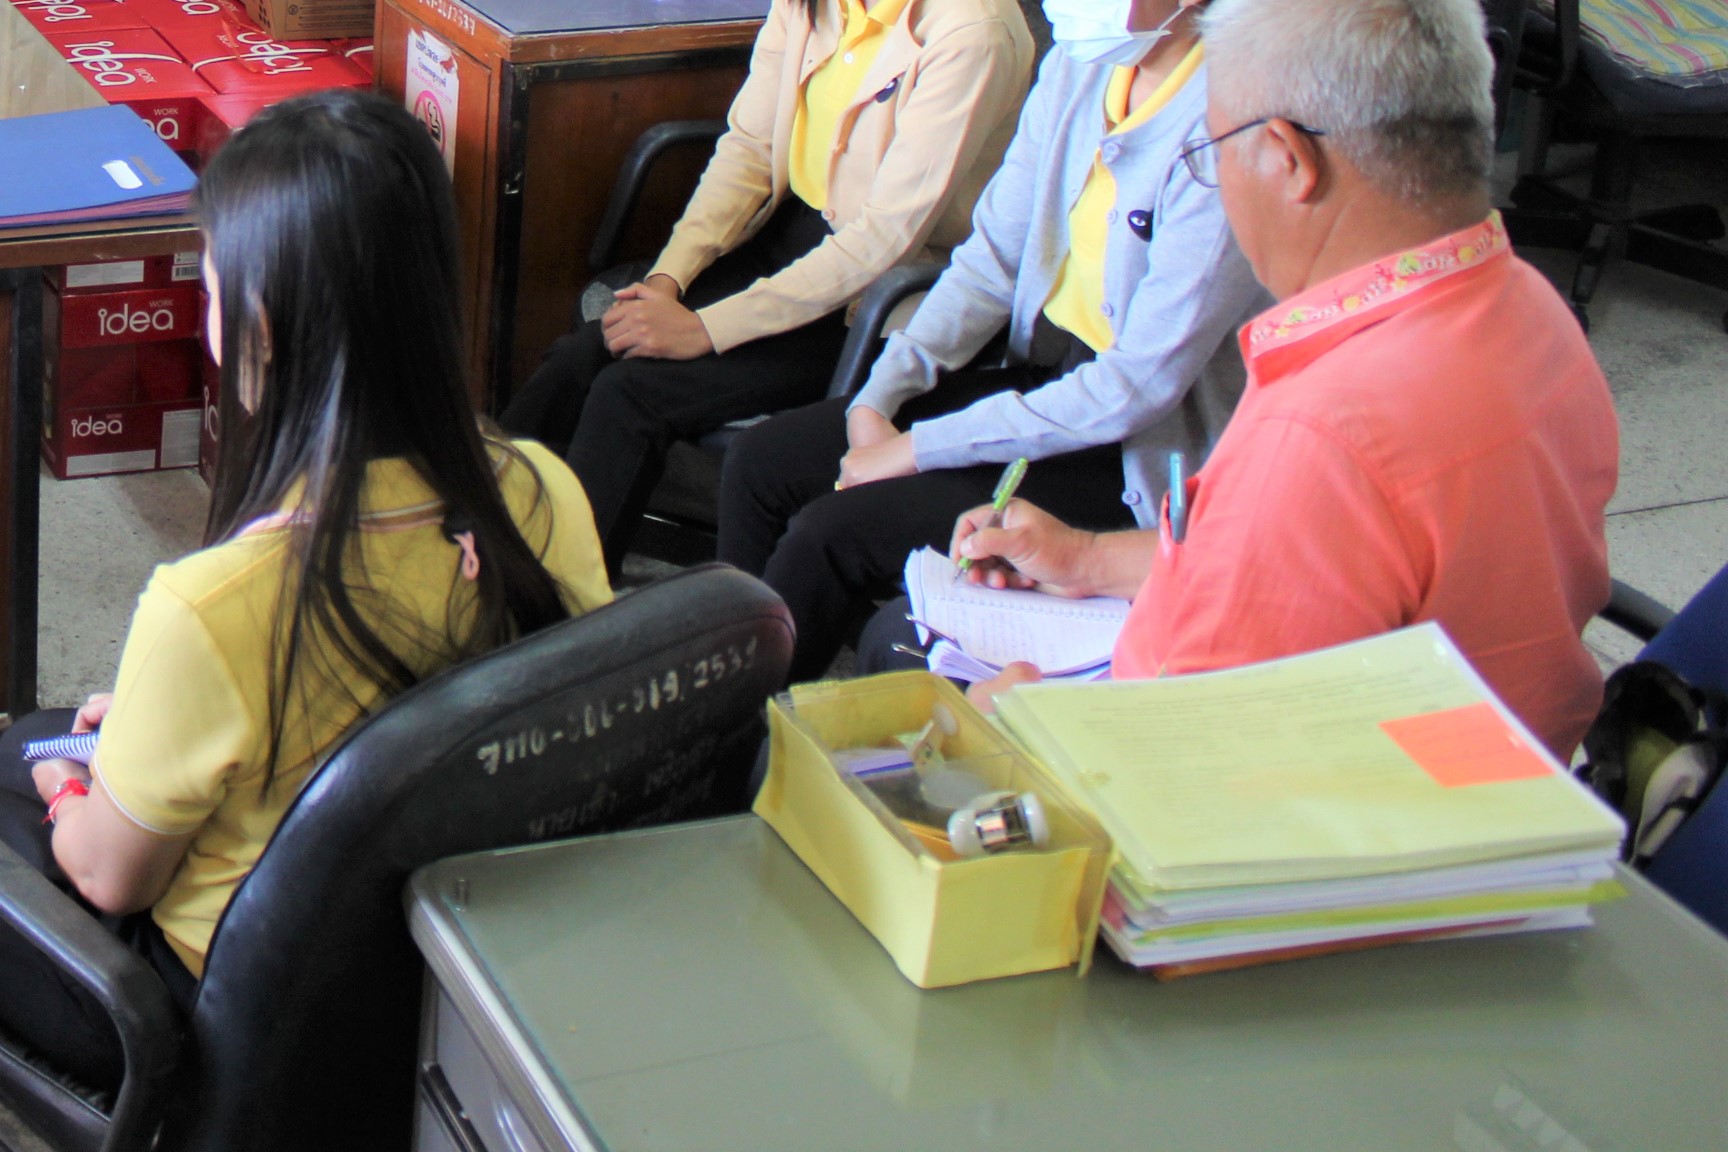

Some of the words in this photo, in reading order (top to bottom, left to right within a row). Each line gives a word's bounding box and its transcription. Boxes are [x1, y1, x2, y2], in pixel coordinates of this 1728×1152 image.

[65, 40, 136, 87] idea
[153, 107, 180, 117] WORK
[98, 303, 174, 336] idea
[71, 415, 122, 438] idea
